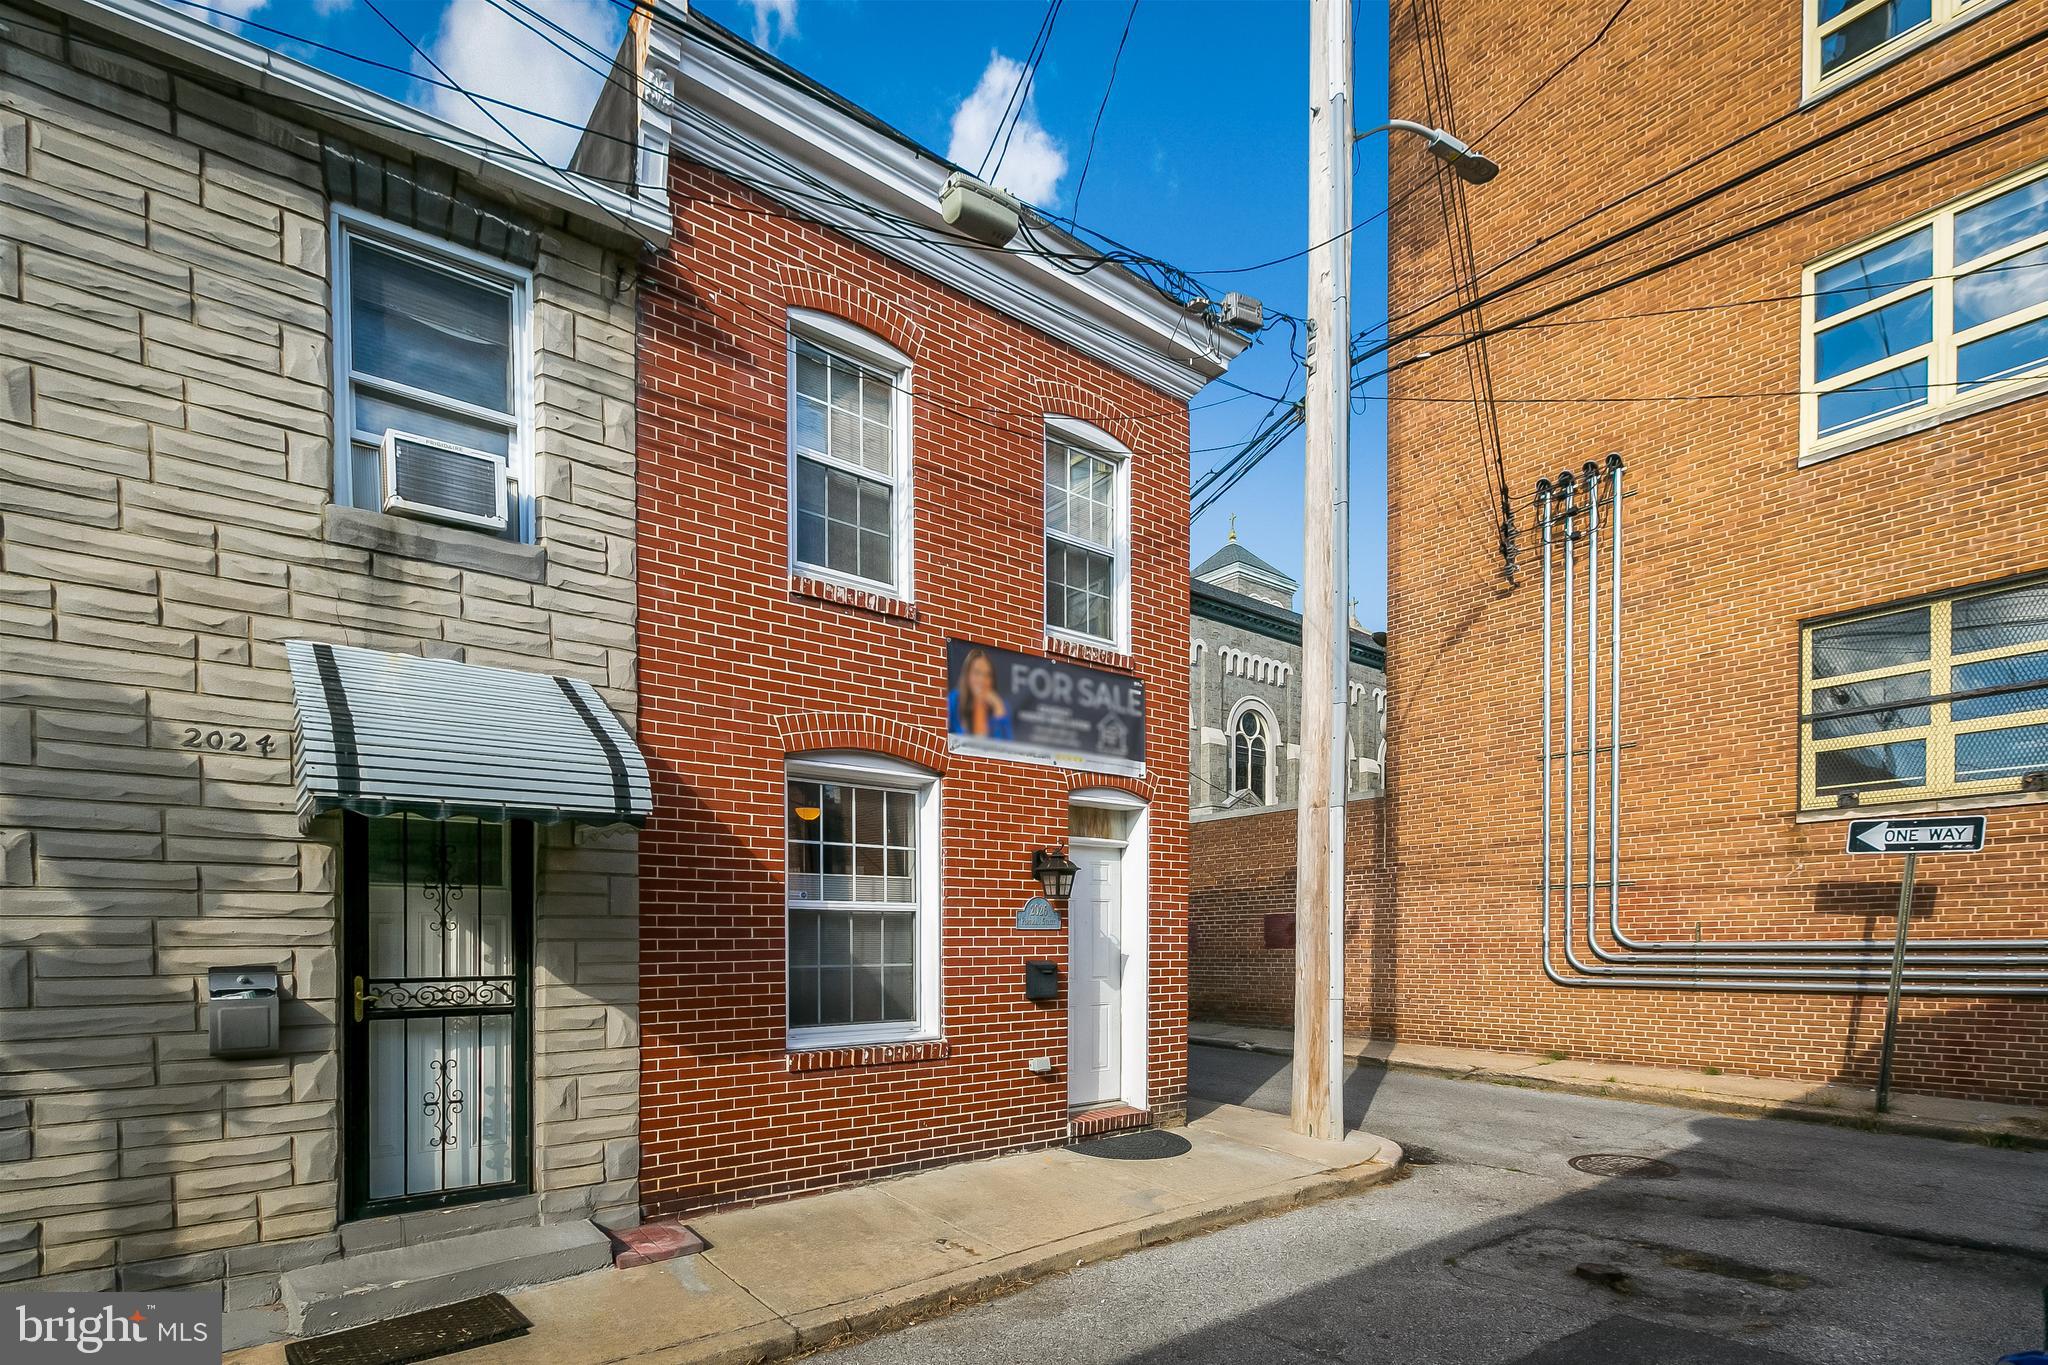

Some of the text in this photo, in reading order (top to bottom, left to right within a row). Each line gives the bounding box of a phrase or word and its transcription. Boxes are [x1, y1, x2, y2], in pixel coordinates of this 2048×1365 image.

[1011, 663, 1143, 717] FOR SALE
[181, 727, 275, 757] 2024
[1884, 827, 1968, 843] ONE WAY
